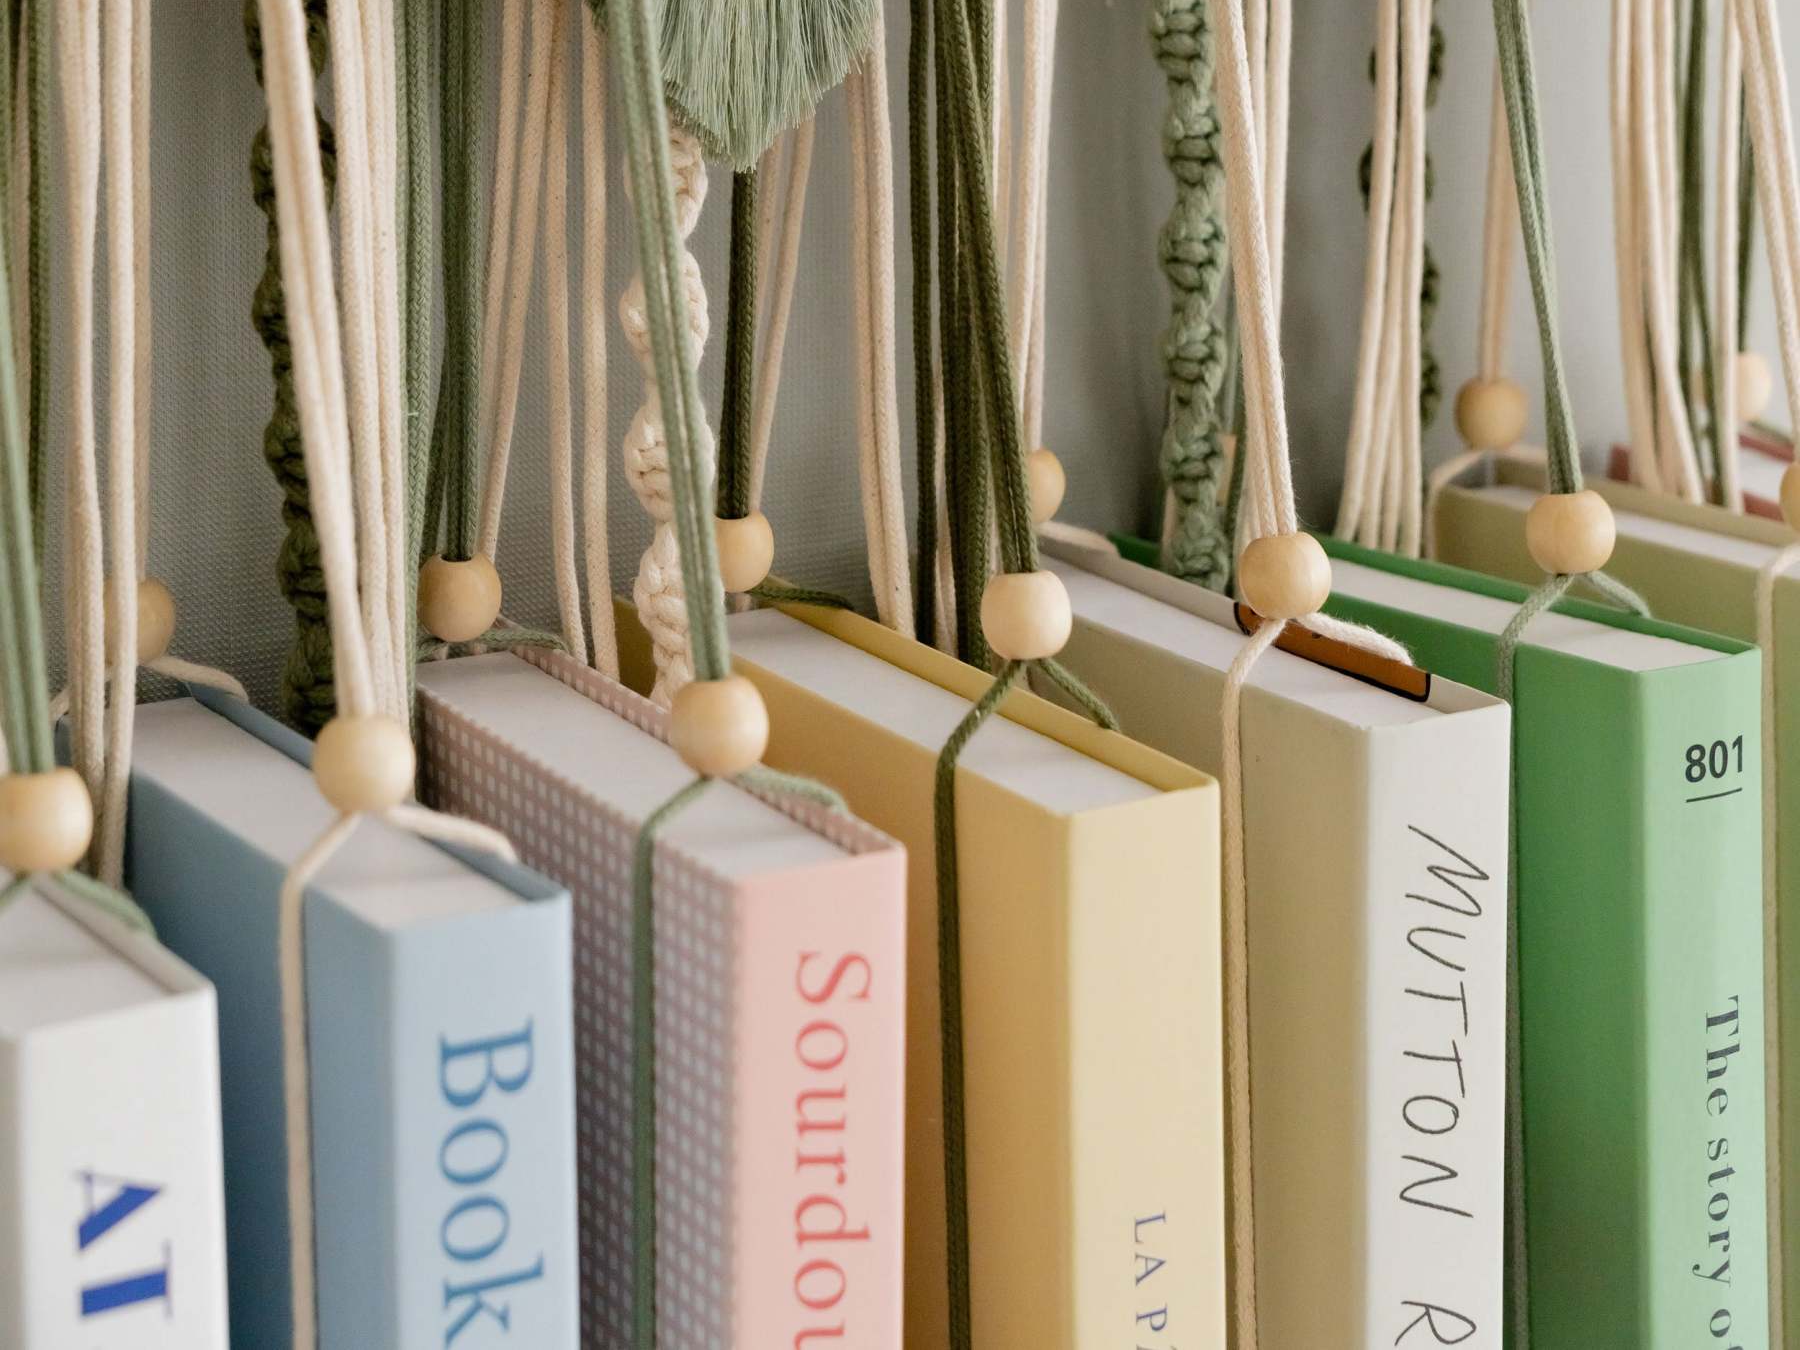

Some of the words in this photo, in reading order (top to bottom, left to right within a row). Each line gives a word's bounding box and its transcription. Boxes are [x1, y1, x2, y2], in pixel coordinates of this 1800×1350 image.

[1685, 734, 1744, 784] 801
[1400, 824, 1490, 1218] MUTTON
[1705, 994, 1741, 1117] The
[438, 1015, 545, 1350] Book
[1691, 1137, 1737, 1288] story
[1134, 1210, 1167, 1286] LA
[1135, 1303, 1178, 1350] P
[1708, 1308, 1744, 1350] o
